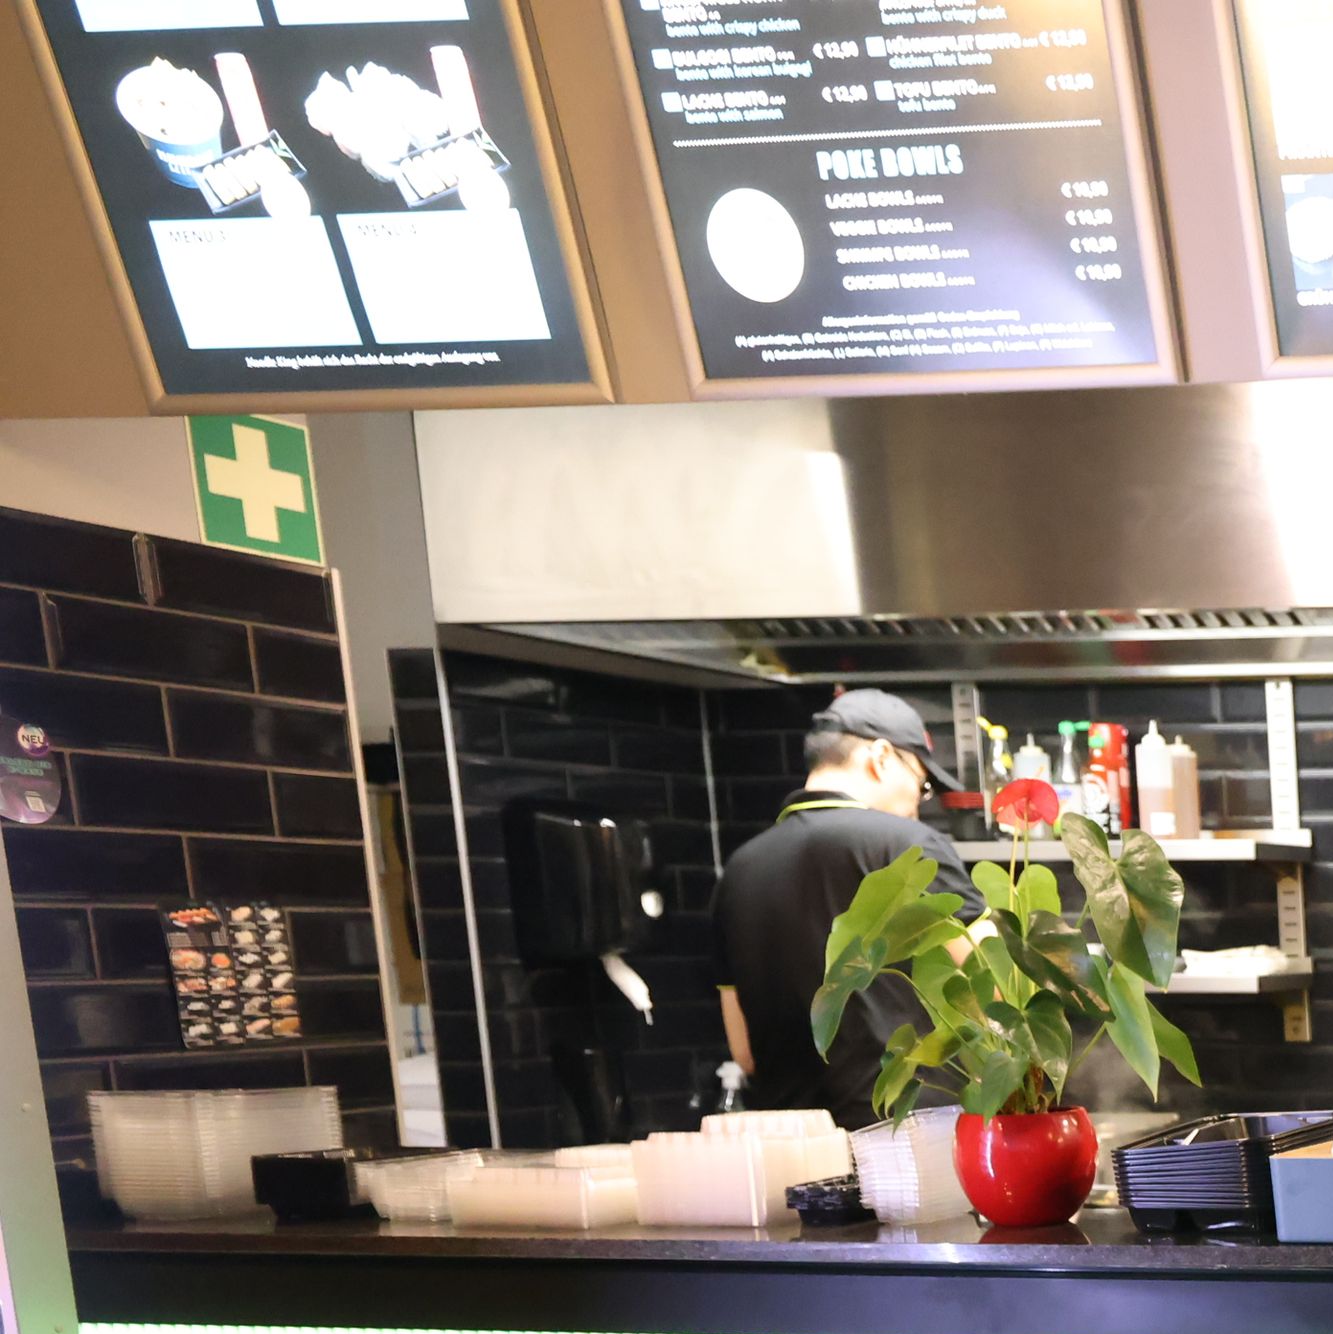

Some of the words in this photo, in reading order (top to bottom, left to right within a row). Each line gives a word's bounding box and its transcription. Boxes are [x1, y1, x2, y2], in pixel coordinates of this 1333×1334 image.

[816, 149, 878, 180] POKE
[880, 144, 963, 177] BOWLS
[21, 734, 45, 744] NEU
